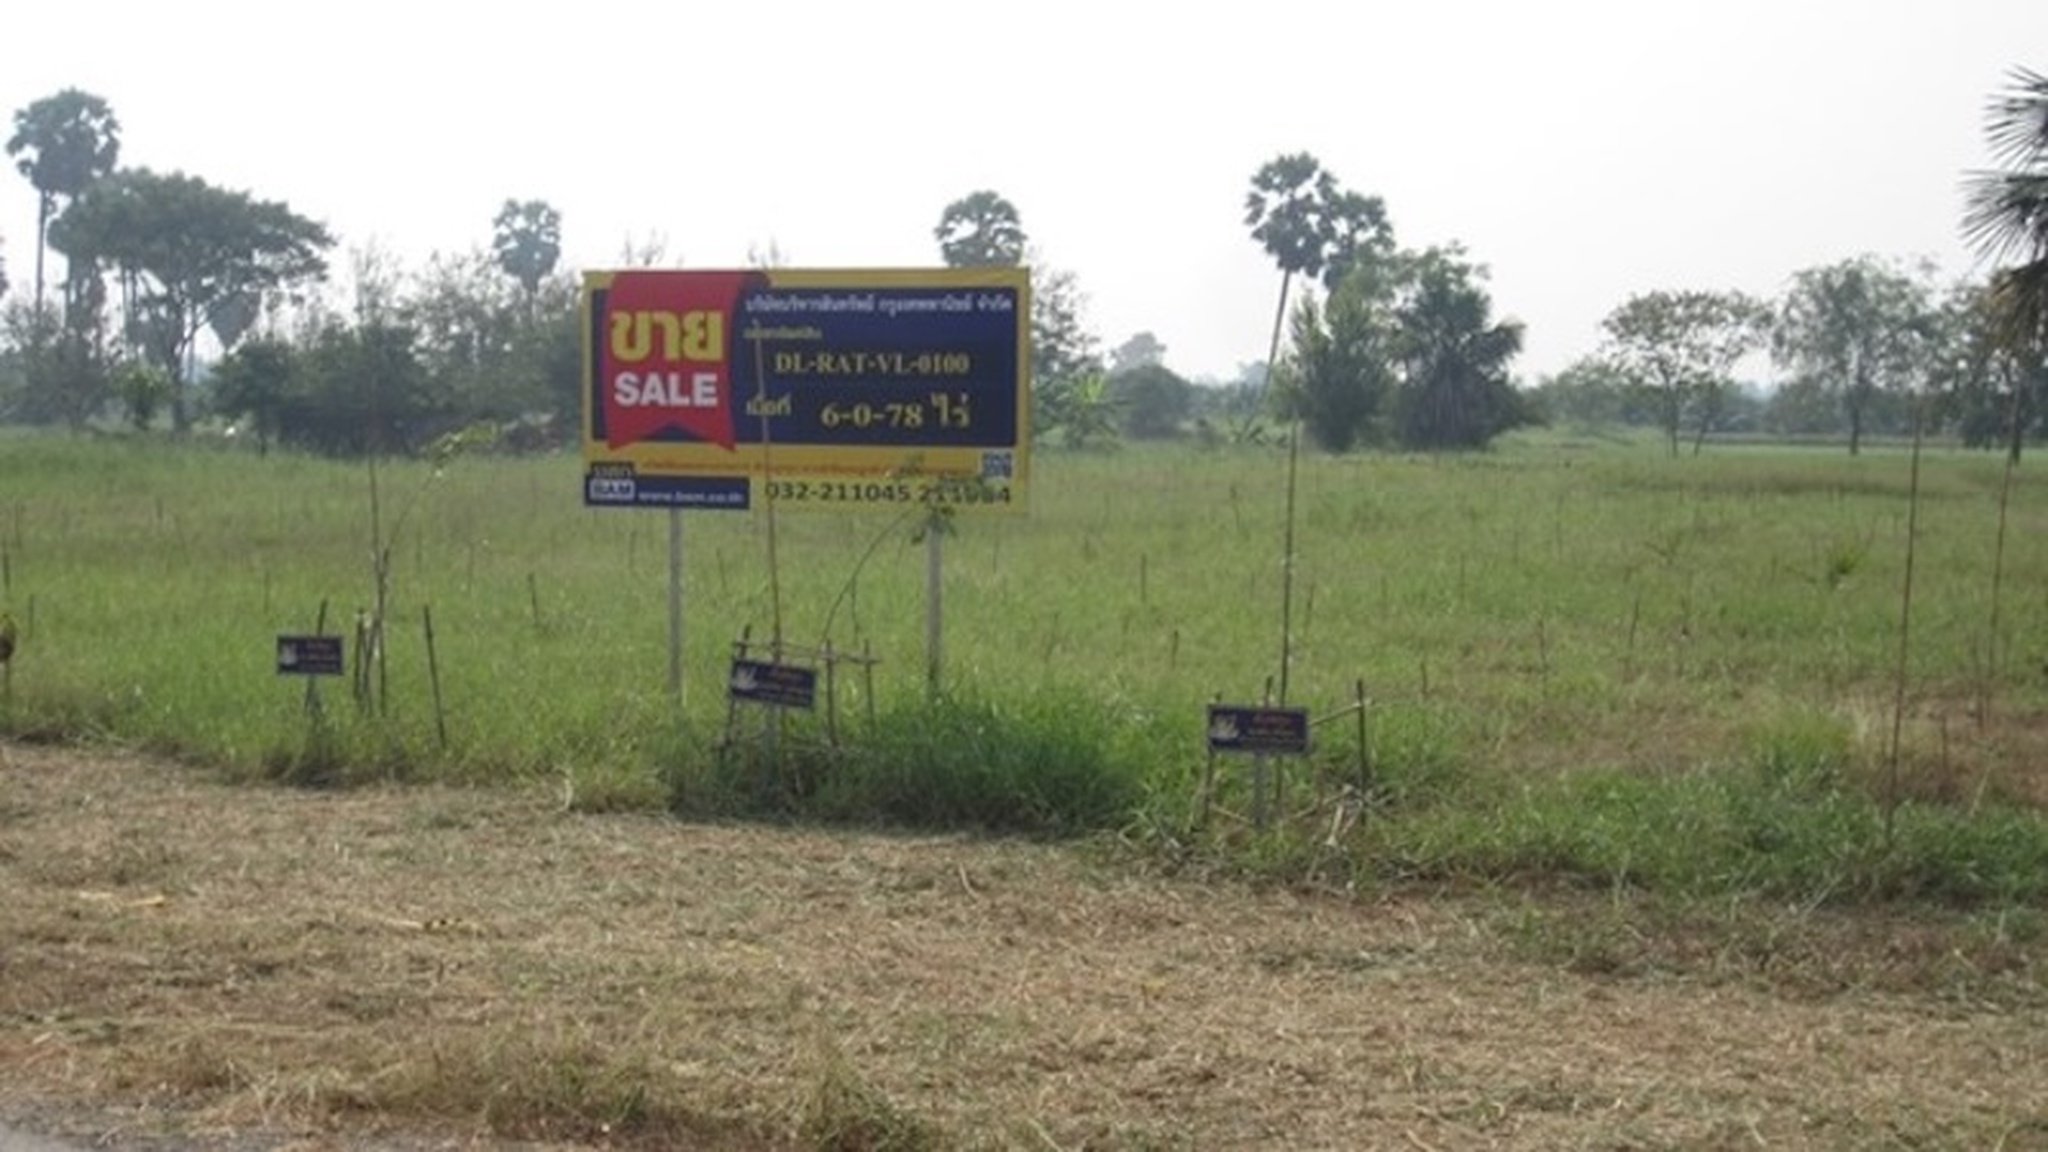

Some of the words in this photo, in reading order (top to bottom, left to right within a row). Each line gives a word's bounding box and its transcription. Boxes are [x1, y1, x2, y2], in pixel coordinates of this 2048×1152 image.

[611, 309, 724, 361] ขาย
[775, 352, 970, 374] DL-RAT-VL-0100
[614, 371, 718, 406] SALE
[821, 402, 924, 427] 6-0-78
[764, 481, 911, 502] 032-211045
